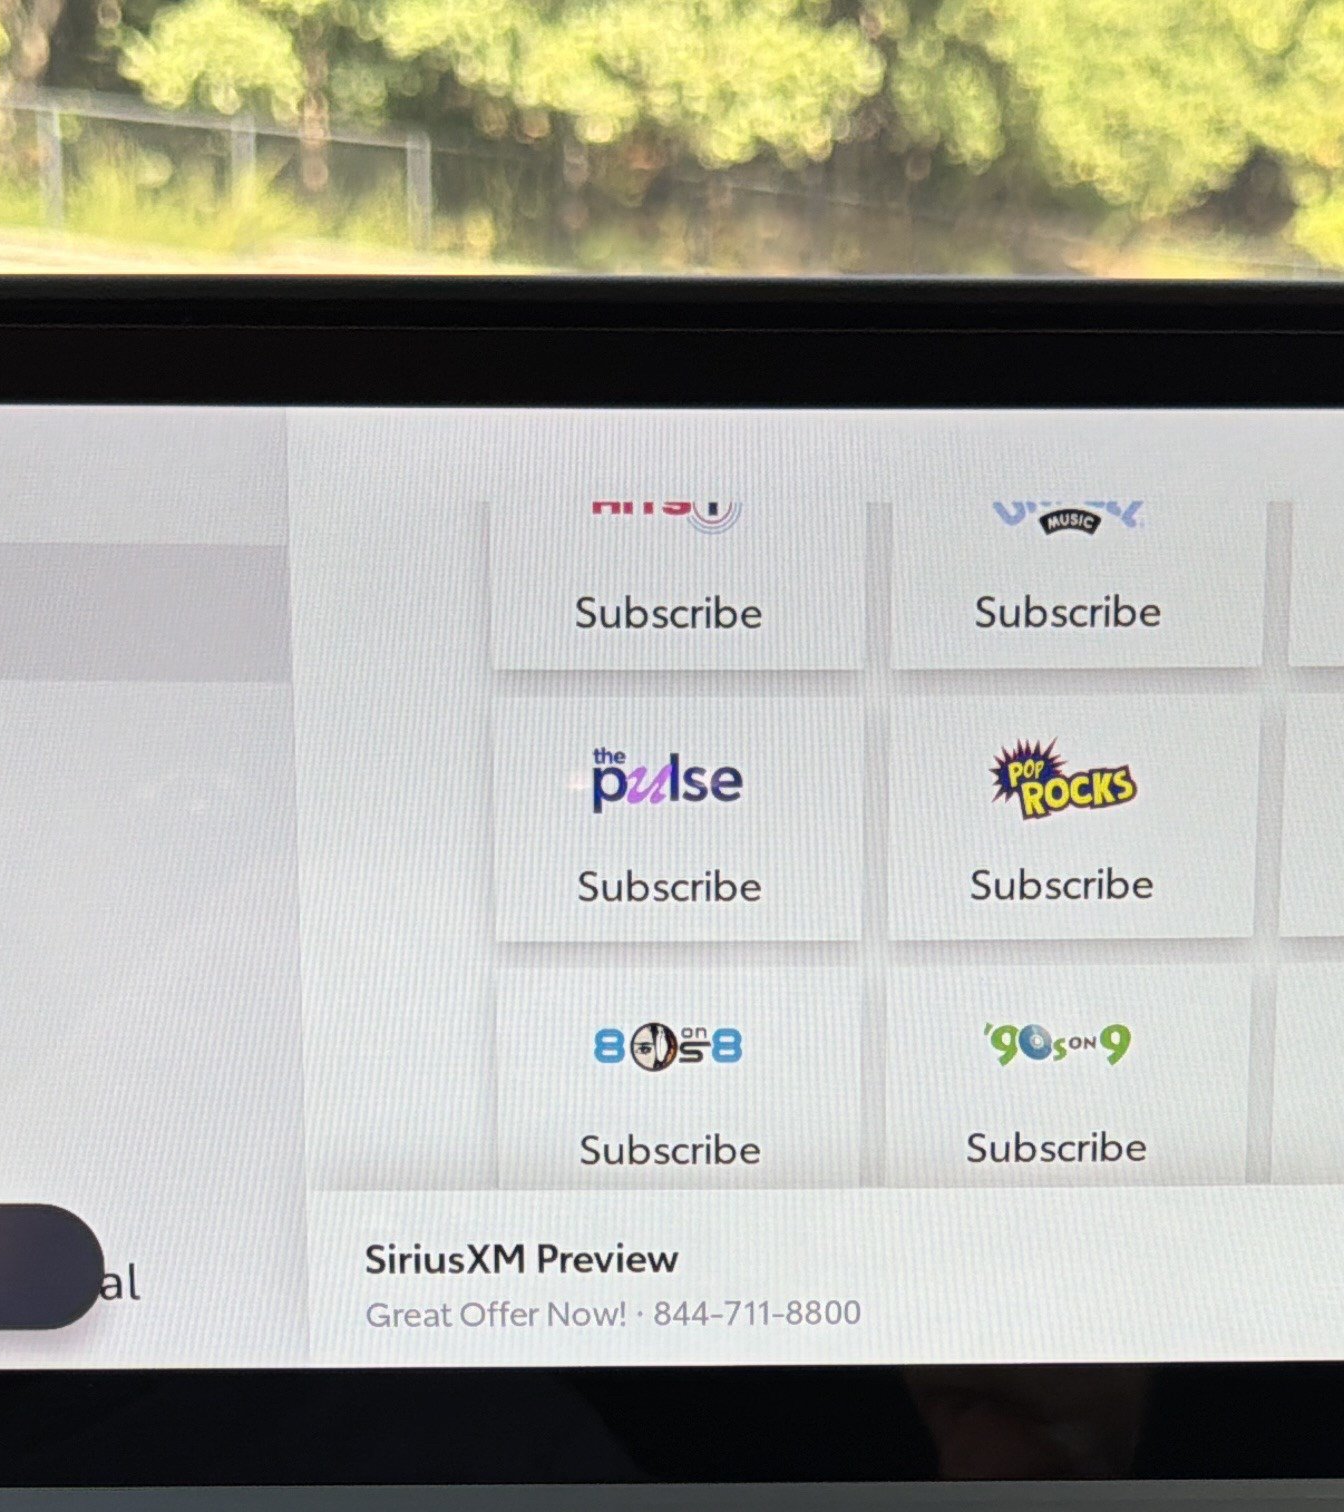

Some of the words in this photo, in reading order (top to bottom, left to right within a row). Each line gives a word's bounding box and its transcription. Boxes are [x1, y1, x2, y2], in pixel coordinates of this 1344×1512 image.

[1046, 513, 1096, 531] MUSIC
[575, 594, 762, 629] Subscribe
[975, 593, 1161, 628] Subscribe
[593, 747, 626, 764] the
[593, 753, 743, 813] pulse
[1007, 758, 1045, 788] POP
[1020, 768, 1135, 817] ROCKS
[578, 869, 762, 902] Subscribe
[971, 867, 1154, 900] Subscribe
[580, 1133, 761, 1165] Subscribe
[967, 1131, 1147, 1162] Subscribe
[365, 1243, 525, 1275] SiriusXM
[538, 1243, 679, 1274] Preview
[365, 1301, 452, 1328] Great
[459, 1300, 540, 1328] Offer
[548, 1300, 626, 1327] Now!
[654, 1299, 862, 1326] 844-711-8800
